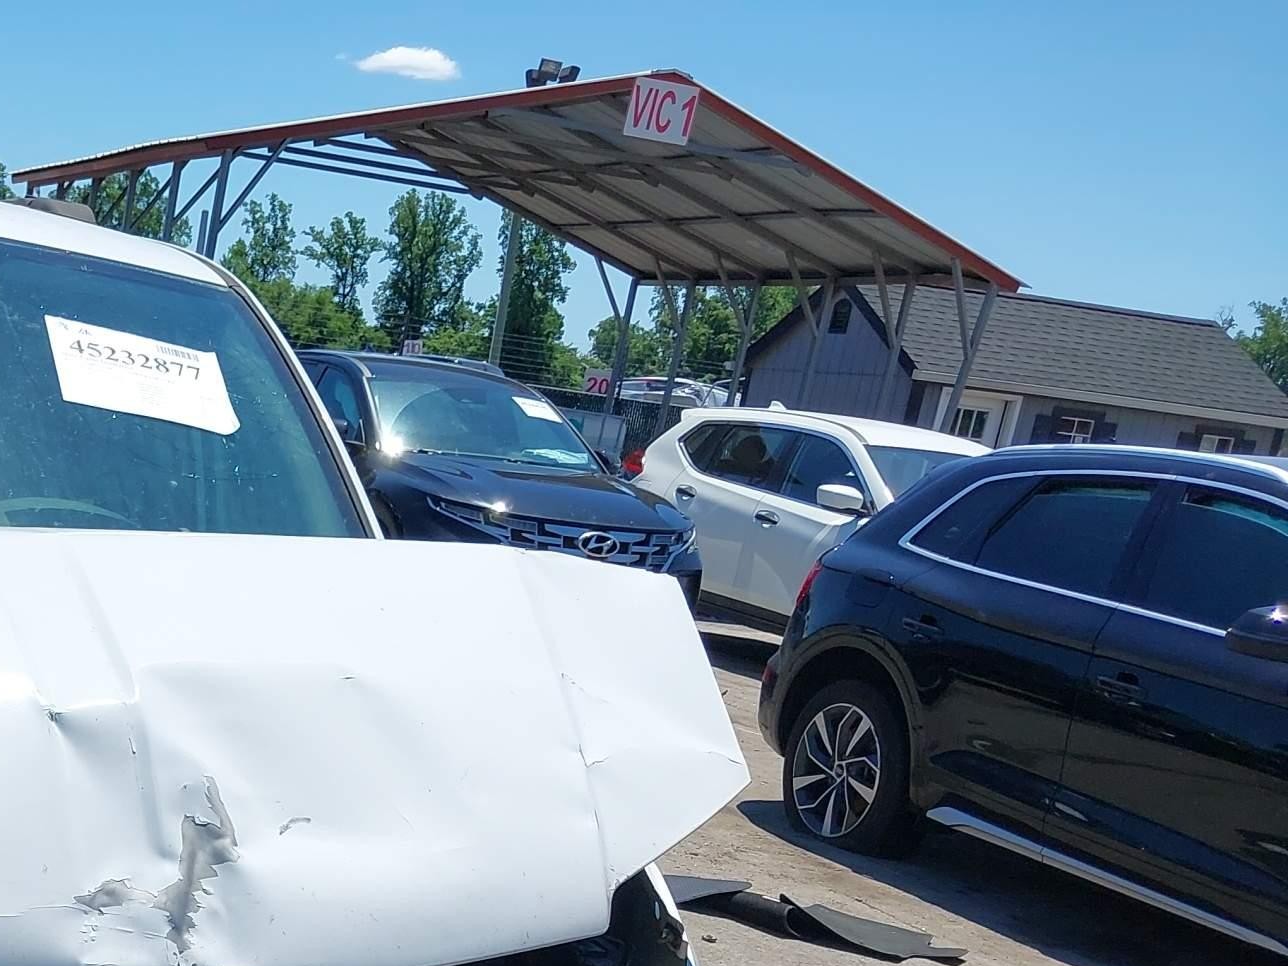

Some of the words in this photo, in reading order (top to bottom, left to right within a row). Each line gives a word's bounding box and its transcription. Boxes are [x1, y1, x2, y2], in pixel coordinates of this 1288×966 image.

[632, 85, 676, 133] VIC
[680, 95, 697, 137] 1
[69, 339, 200, 381] 45232877
[586, 376, 609, 395] 20
